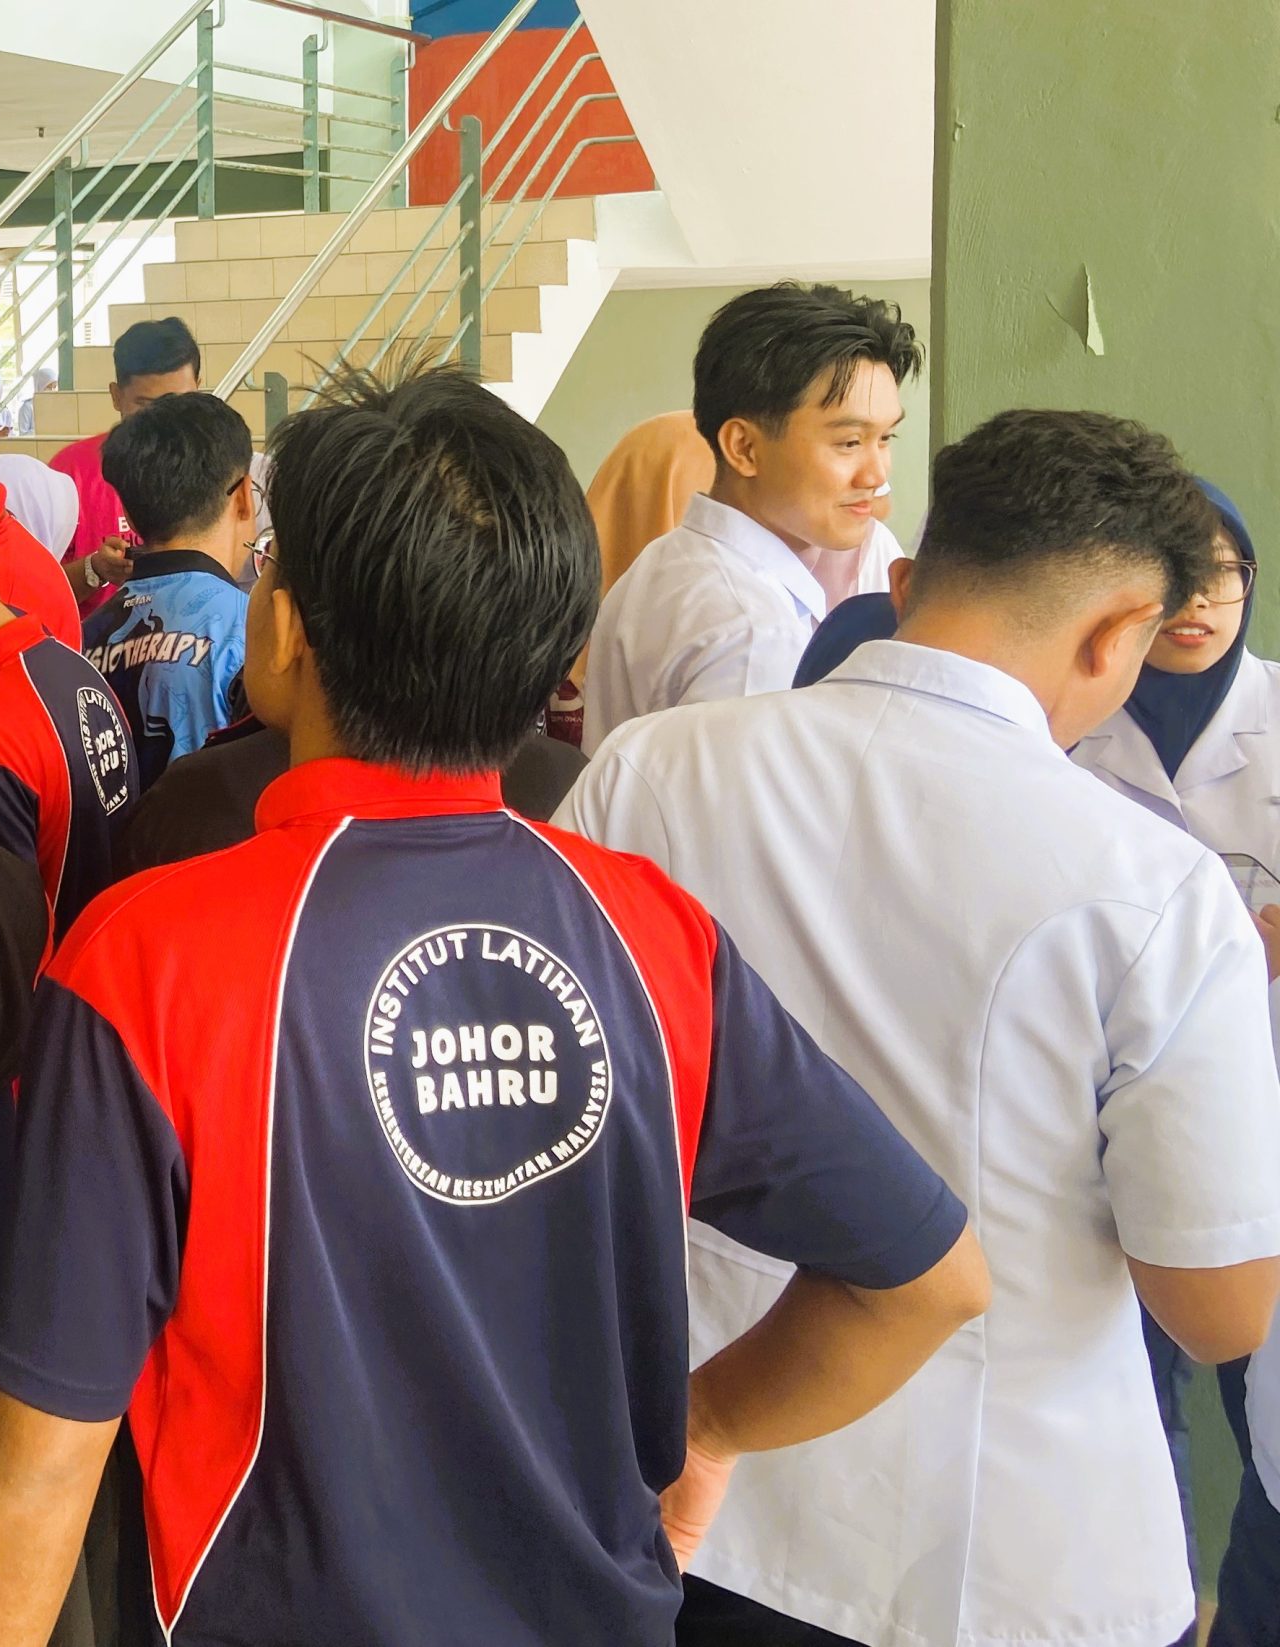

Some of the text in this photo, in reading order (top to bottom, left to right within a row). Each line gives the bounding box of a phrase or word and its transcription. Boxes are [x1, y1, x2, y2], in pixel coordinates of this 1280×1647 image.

[85, 630, 212, 674] SIOTHERAPY
[371, 931, 601, 1056] INSTITUT LATIHAN
[411, 1024, 557, 1069] JOHOR
[415, 1069, 558, 1115] BAHRU
[372, 1059, 608, 1197] KEMENTERIAN KESIHATAN MALAYSIA
